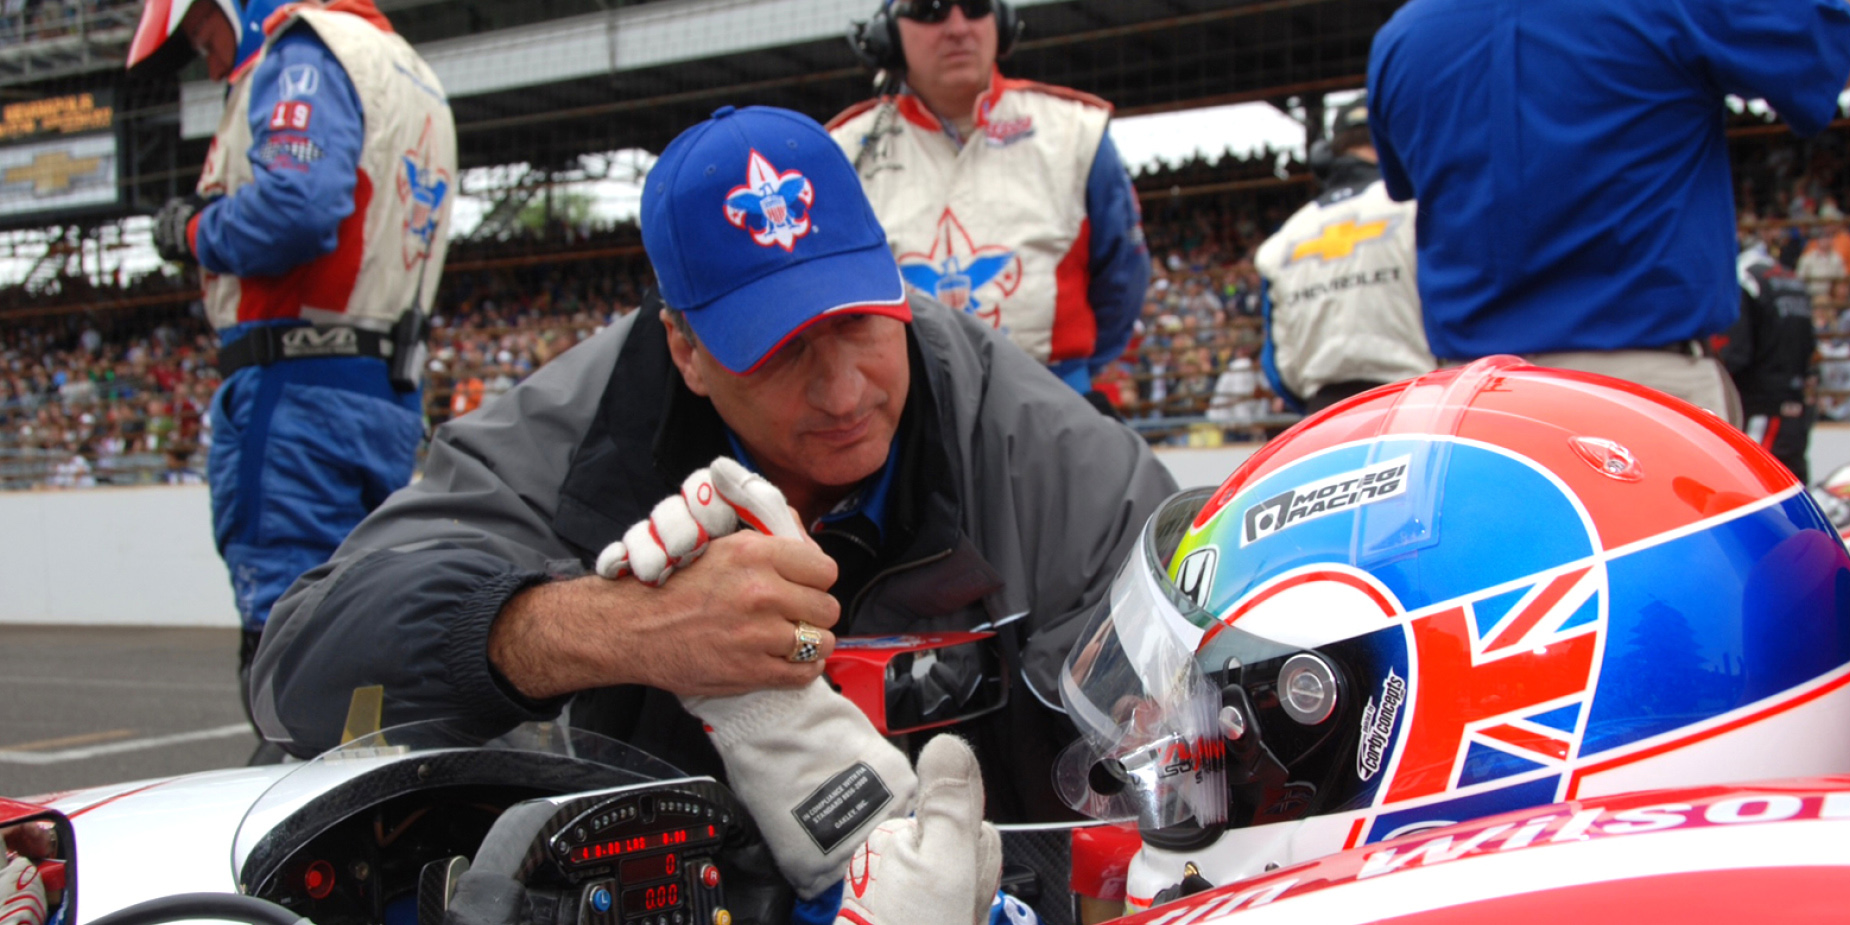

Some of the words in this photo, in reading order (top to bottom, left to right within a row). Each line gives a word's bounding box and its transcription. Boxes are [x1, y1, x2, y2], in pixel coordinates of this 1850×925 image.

[272, 103, 309, 128] 19
[1286, 479, 1401, 523] RACING
[1292, 464, 1407, 507] MOTEGI
[1364, 729, 1387, 770] corby
[1376, 675, 1403, 734] concepts
[809, 784, 845, 816] COMPLIANCE
[842, 773, 858, 788] WITH
[812, 797, 843, 824] STANDARD
[665, 853, 676, 876] 0
